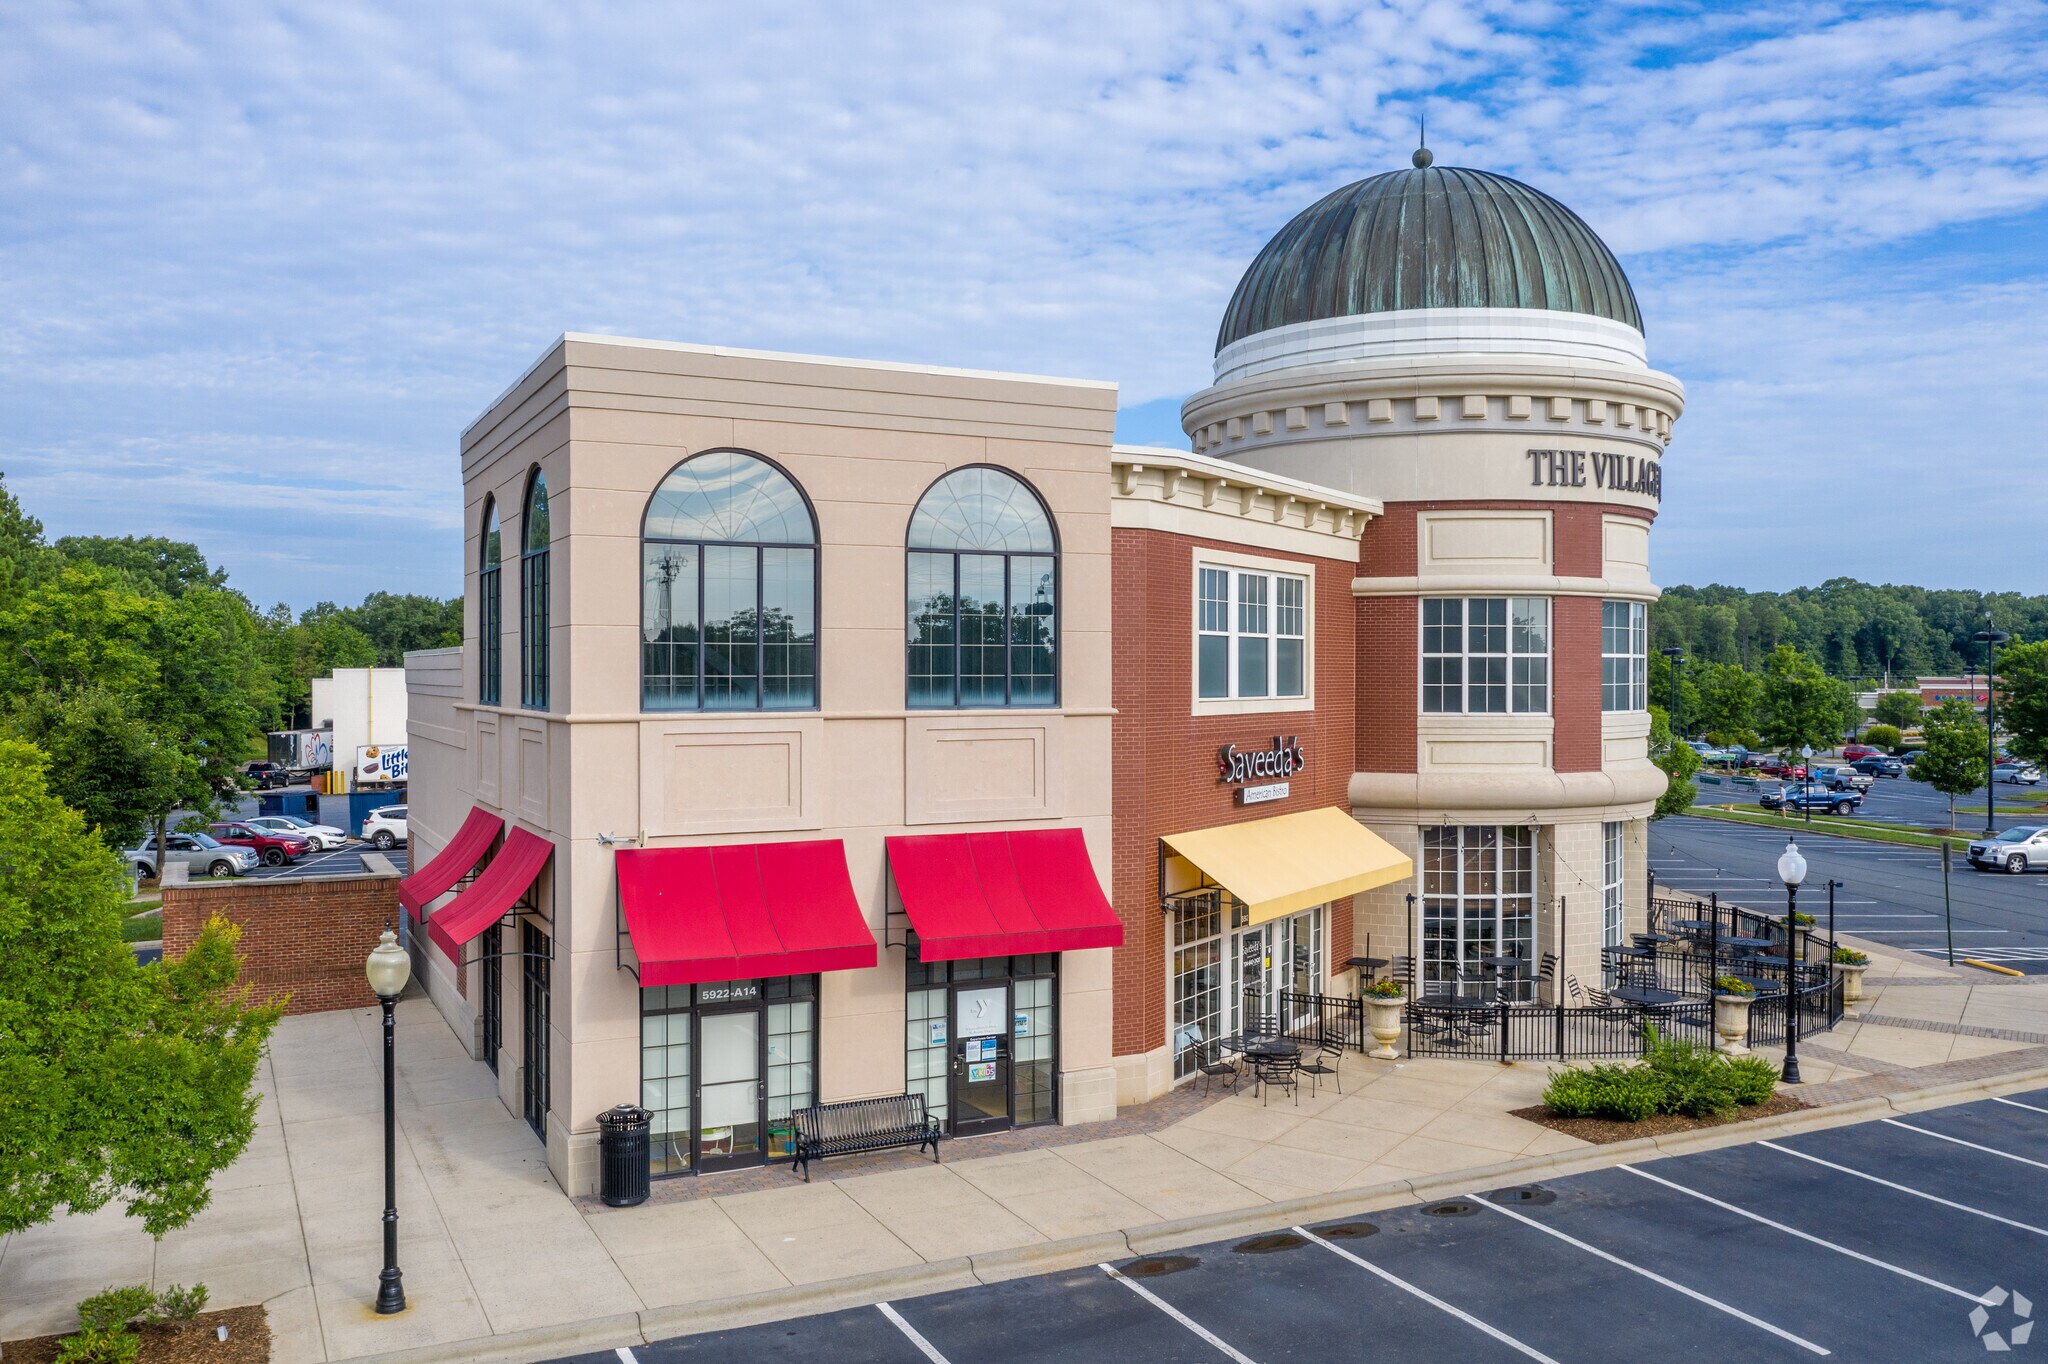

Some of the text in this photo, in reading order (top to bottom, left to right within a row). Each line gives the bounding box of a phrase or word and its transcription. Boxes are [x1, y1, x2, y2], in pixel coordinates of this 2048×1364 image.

[1526, 449, 1587, 487] THE
[1221, 736, 1306, 784] Saveeda's
[1245, 785, 1288, 802] American Bistro
[702, 986, 757, 1000] 5922-A14
